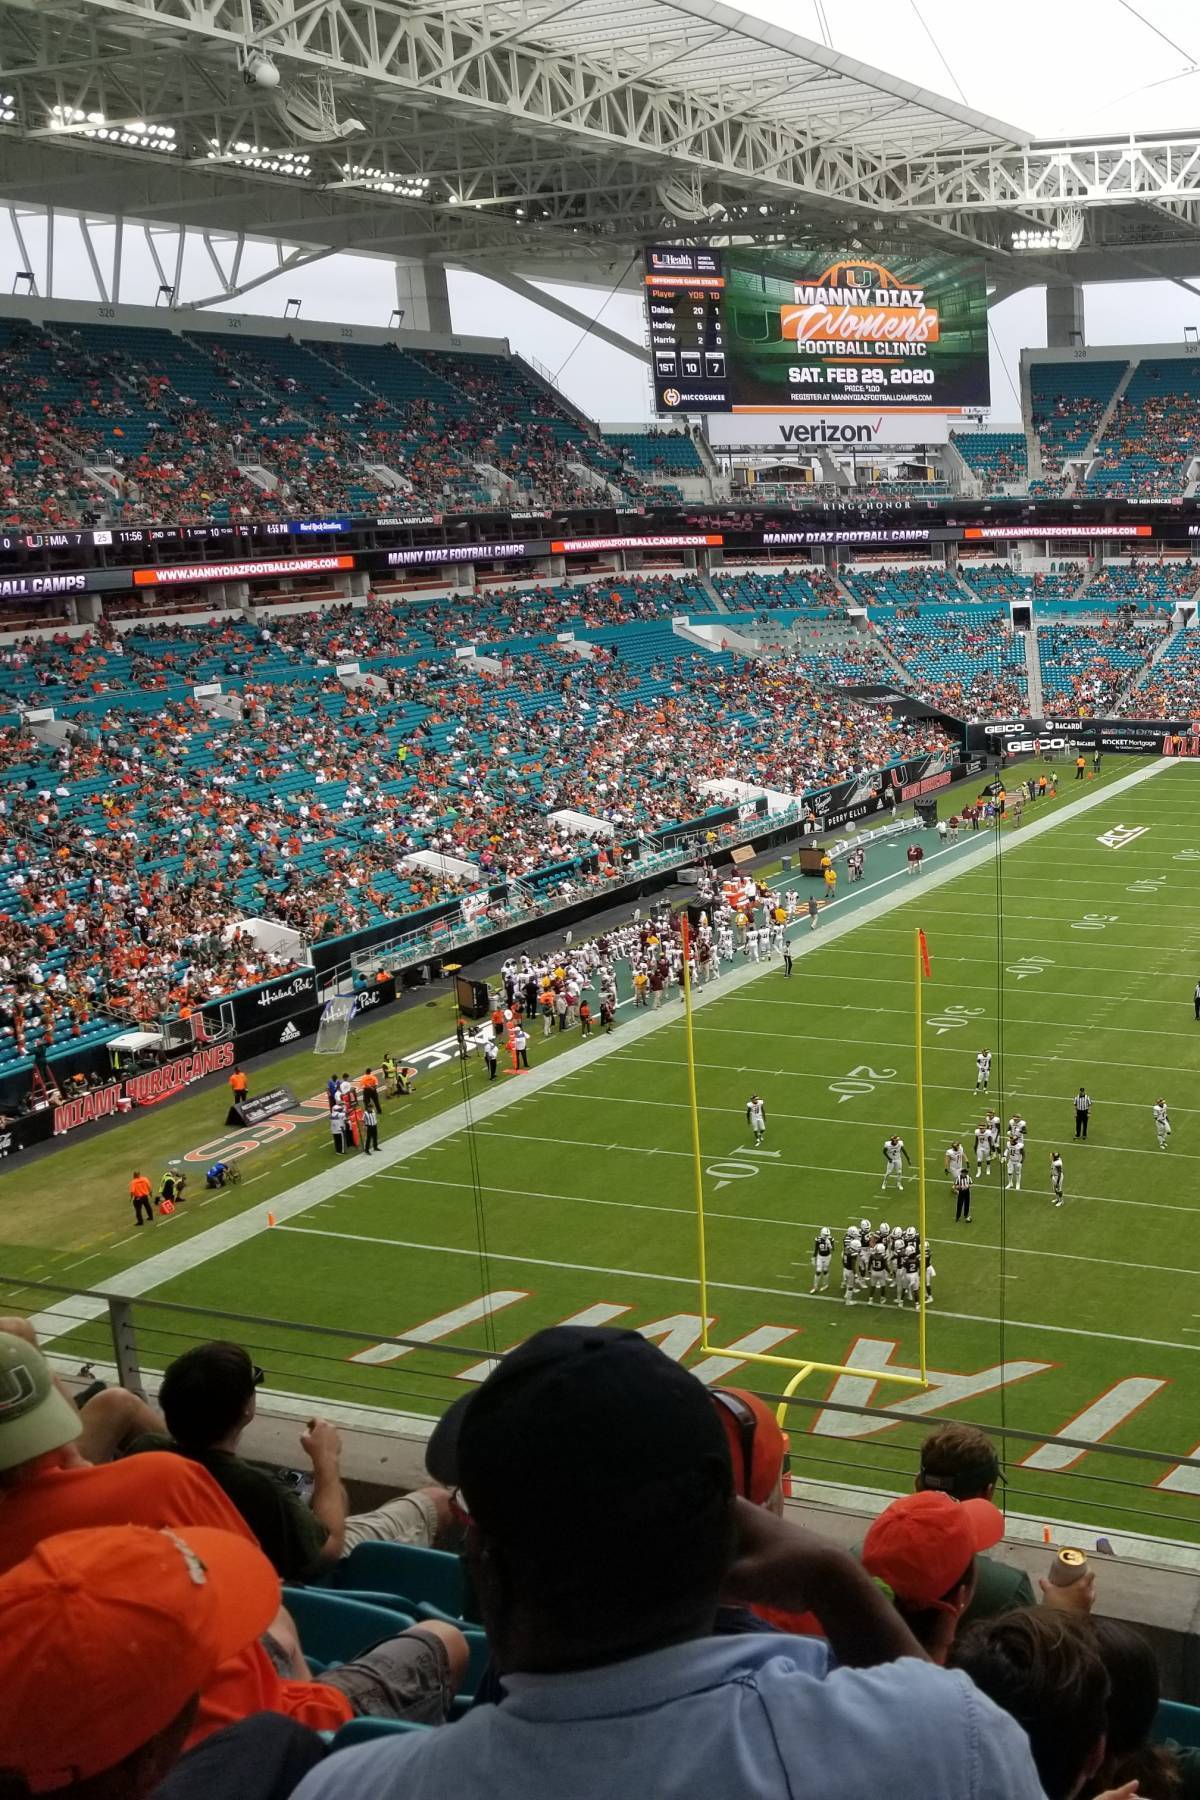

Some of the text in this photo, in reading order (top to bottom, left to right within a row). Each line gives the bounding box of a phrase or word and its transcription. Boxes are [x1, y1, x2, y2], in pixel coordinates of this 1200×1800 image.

[652, 290, 675, 298] Player
[794, 287, 924, 308] MANNY DIAZ
[98, 307, 114, 318] 320
[693, 307, 703, 315] 20
[715, 307, 719, 315] 1
[228, 318, 241, 328] 321
[783, 304, 938, 342] Women's
[340, 328, 352, 337] 322
[653, 336, 675, 344] Harris
[797, 341, 927, 356] FOOTBALL CLINIC
[1073, 350, 1087, 358] 328
[1184, 345, 1198, 353] 329
[659, 363, 719, 373] 1ST 10 7
[788, 367, 935, 385] SAT. FEB 29, 2020
[791, 393, 822, 401] REGISTER
[779, 422, 872, 443] verizon
[823, 501, 912, 510] RING HONOR
[4, 538, 10, 549] 0
[50, 535, 68, 546] MIA
[76, 534, 82, 544] 7
[120, 532, 143, 541] 11:56
[210, 528, 219, 536] 10
[763, 530, 930, 544] MANNY DIAZ FOOTBALL CAMPS
[981, 527, 1137, 537] WWW.MANNYDIAZFOOTBALLCAMPS.COM
[564, 535, 707, 551] WWW.MANNYDIAZFOOTBALLCAMPS.COM
[388, 545, 525, 565] MANNY DIAZ FOOTBALL CAMPS
[156, 557, 338, 581] WWW.MANNYDIAZFOOTBALLCAMPS.COM
[32, 575, 86, 592] CAMPS
[985, 723, 1025, 734] GEICO
[1055, 720, 1083, 731] BACARDÍ
[1007, 738, 1065, 752] GEICO
[1129, 739, 1156, 748] Mortgage
[828, 806, 867, 827] PERRY ELLIS
[1096, 824, 1144, 848] ACC
[258, 977, 313, 1006] Hialeah Park
[926, 1005, 986, 1028] 30
[280, 1030, 300, 1043] adidas
[828, 1065, 897, 1094] 20
[54, 1042, 235, 1133] MIAMI HURRICANES
[706, 1144, 783, 1178] 10
